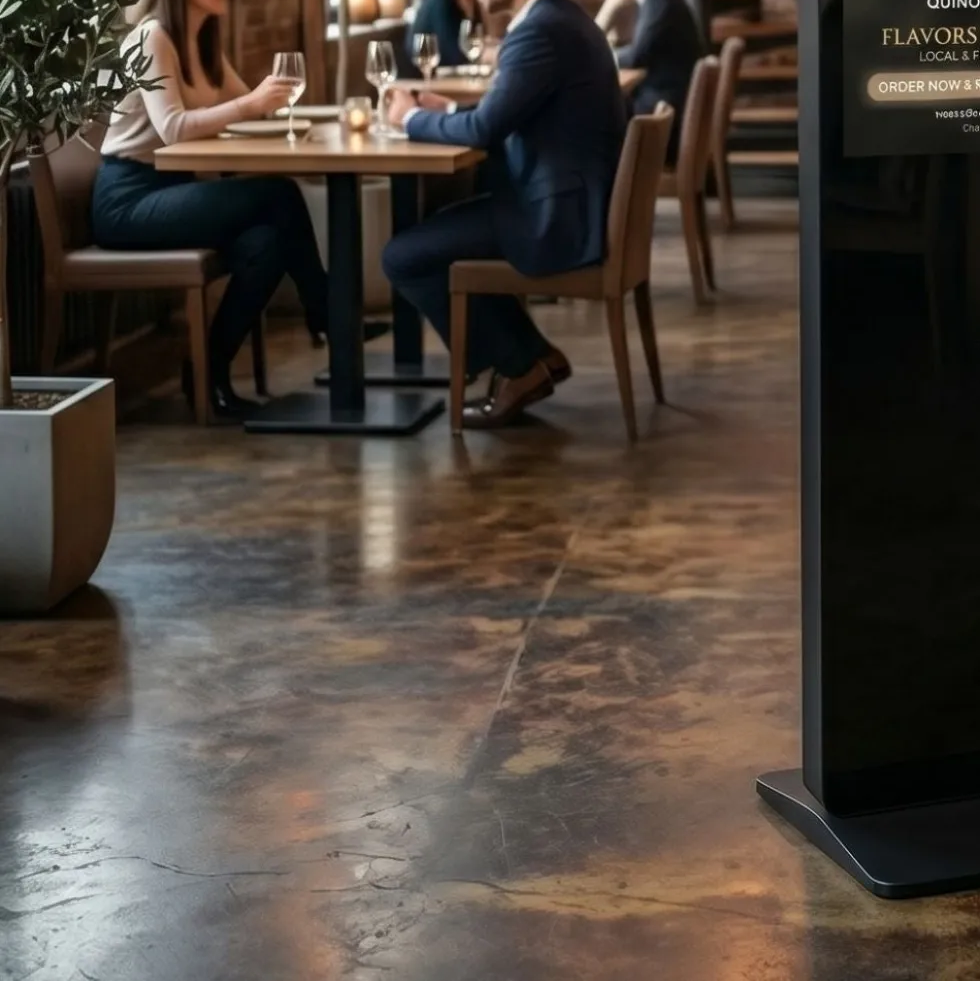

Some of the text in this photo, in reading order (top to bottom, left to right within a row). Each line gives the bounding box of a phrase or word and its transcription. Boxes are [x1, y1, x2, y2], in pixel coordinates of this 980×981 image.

[881, 26, 978, 46] FLAVORS
[919, 50, 960, 62] LOCAL
[961, 50, 971, 62] &
[878, 80, 925, 94] ORDER
[928, 78, 962, 92] NOW
[963, 78, 973, 91] &
